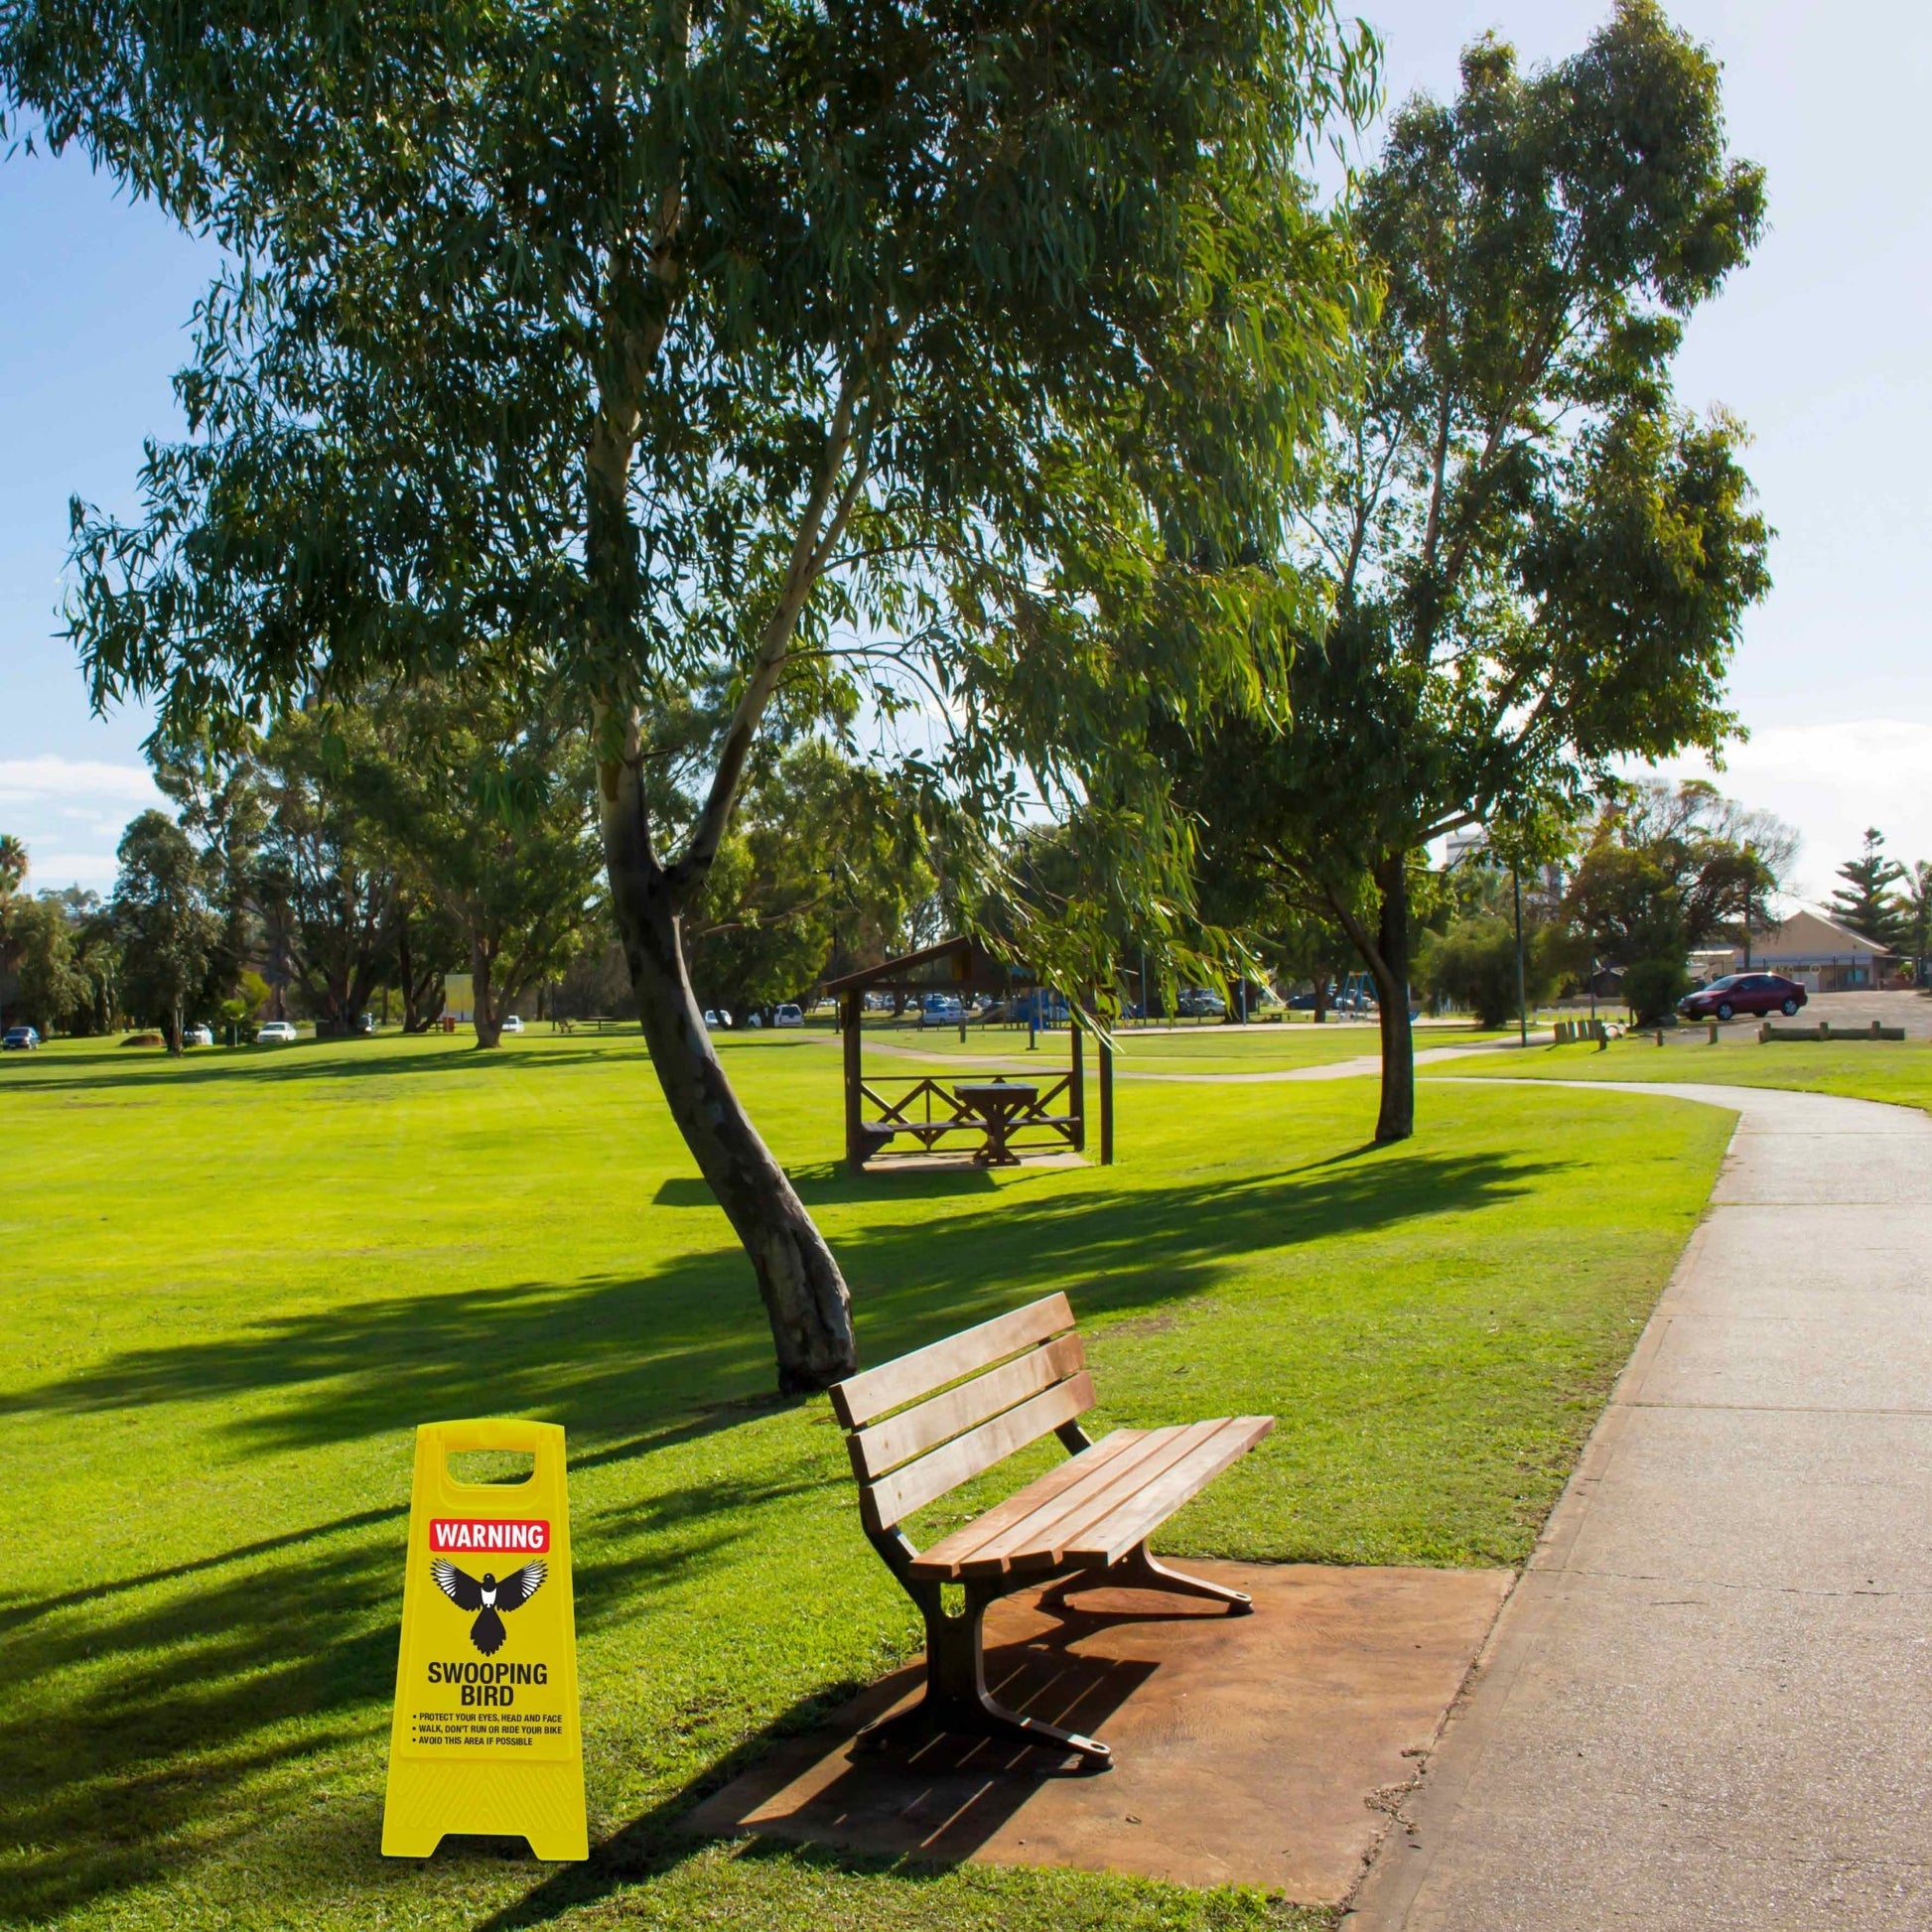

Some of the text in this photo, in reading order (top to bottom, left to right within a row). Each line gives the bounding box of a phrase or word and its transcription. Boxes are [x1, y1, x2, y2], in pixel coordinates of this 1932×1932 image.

[435, 1523, 544, 1549] WARNING
[428, 1662, 548, 1685] SWOOPING
[461, 1685, 514, 1707] BIRD
[419, 1713, 562, 1724] PROTECT YOUR EYES, HEAD AND FACE
[419, 1725, 443, 1733] WALK,
[445, 1725, 468, 1733] DON'T
[471, 1725, 487, 1733] RUN
[501, 1725, 520, 1734] RIDE
[521, 1725, 542, 1734] YOUR
[544, 1725, 562, 1734] BIKE
[419, 1735, 443, 1745] AVOID
[445, 1736, 463, 1745] THIS
[464, 1736, 484, 1745] AREA
[495, 1737, 533, 1746] POSSIBLE
